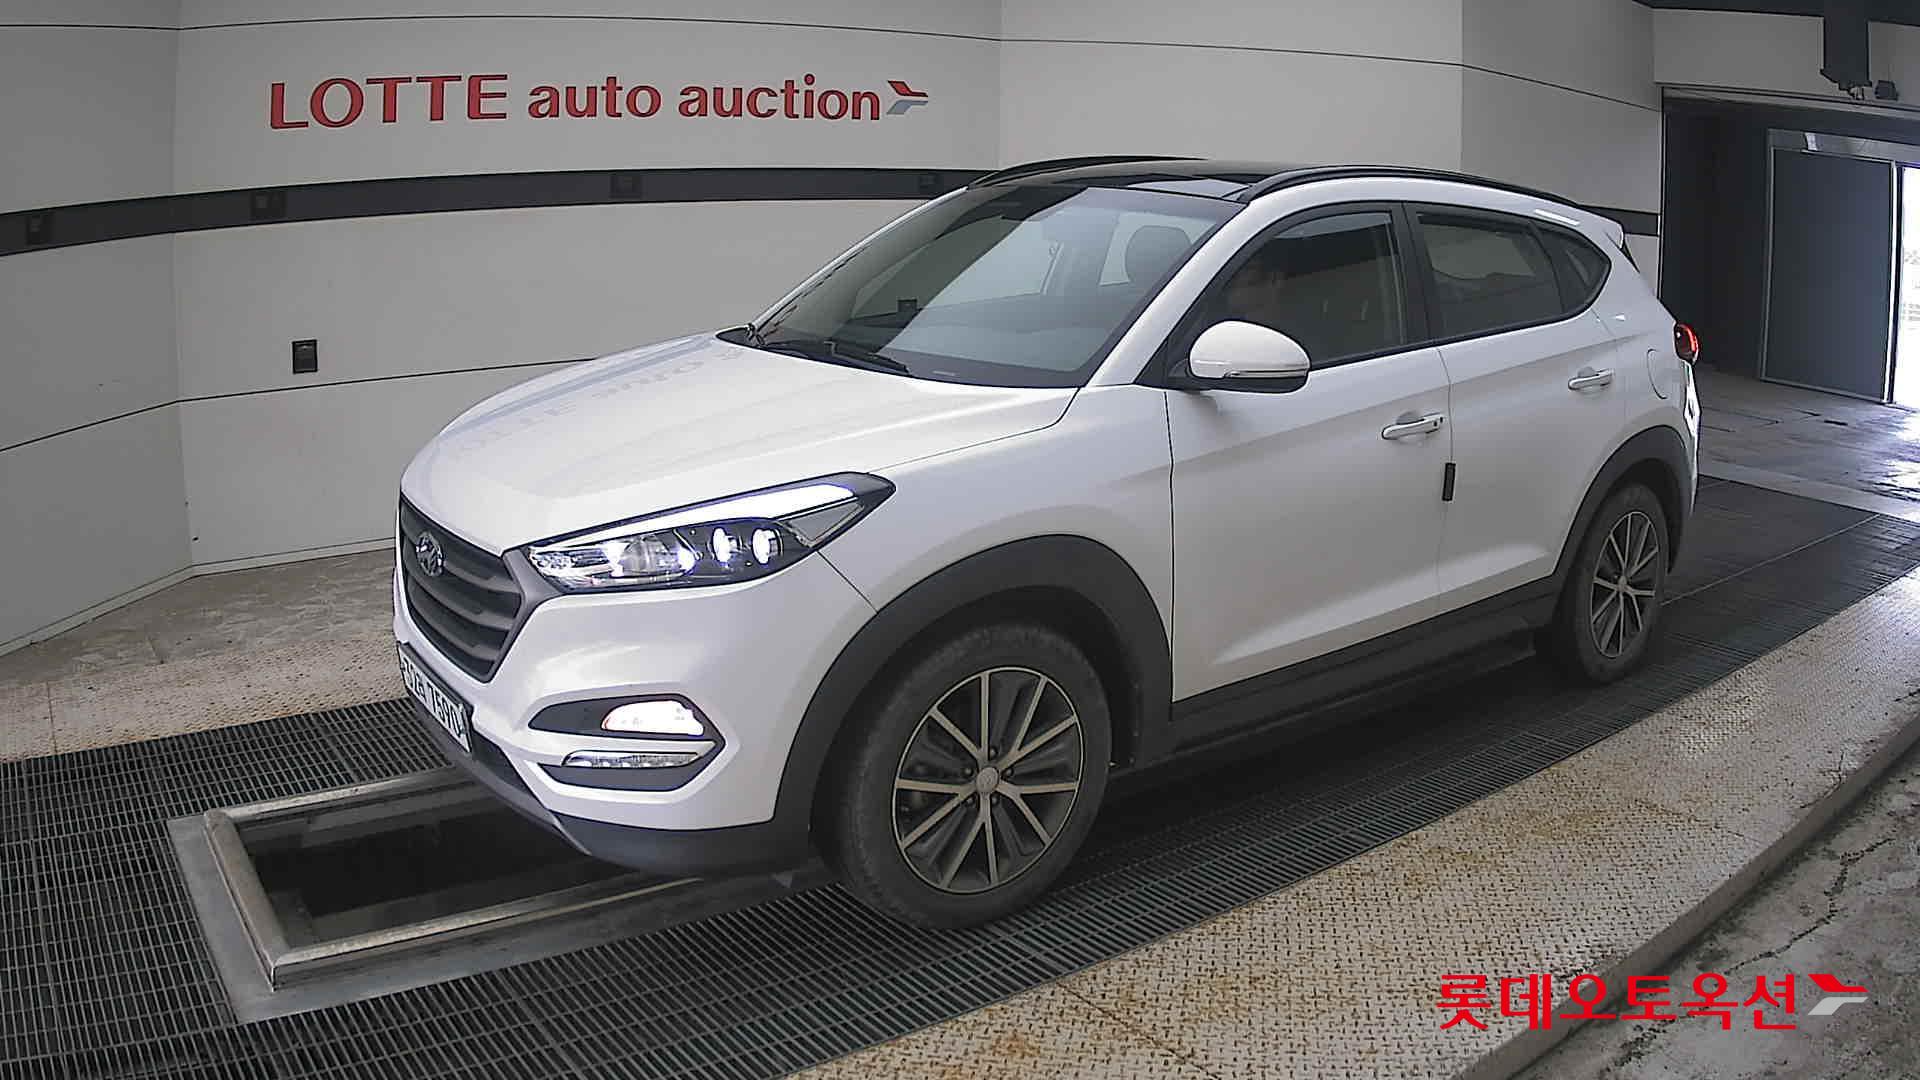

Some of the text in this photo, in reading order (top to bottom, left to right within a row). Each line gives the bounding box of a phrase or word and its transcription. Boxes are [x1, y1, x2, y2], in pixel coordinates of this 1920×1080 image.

[271, 73, 881, 129] LOTTE auto auction
